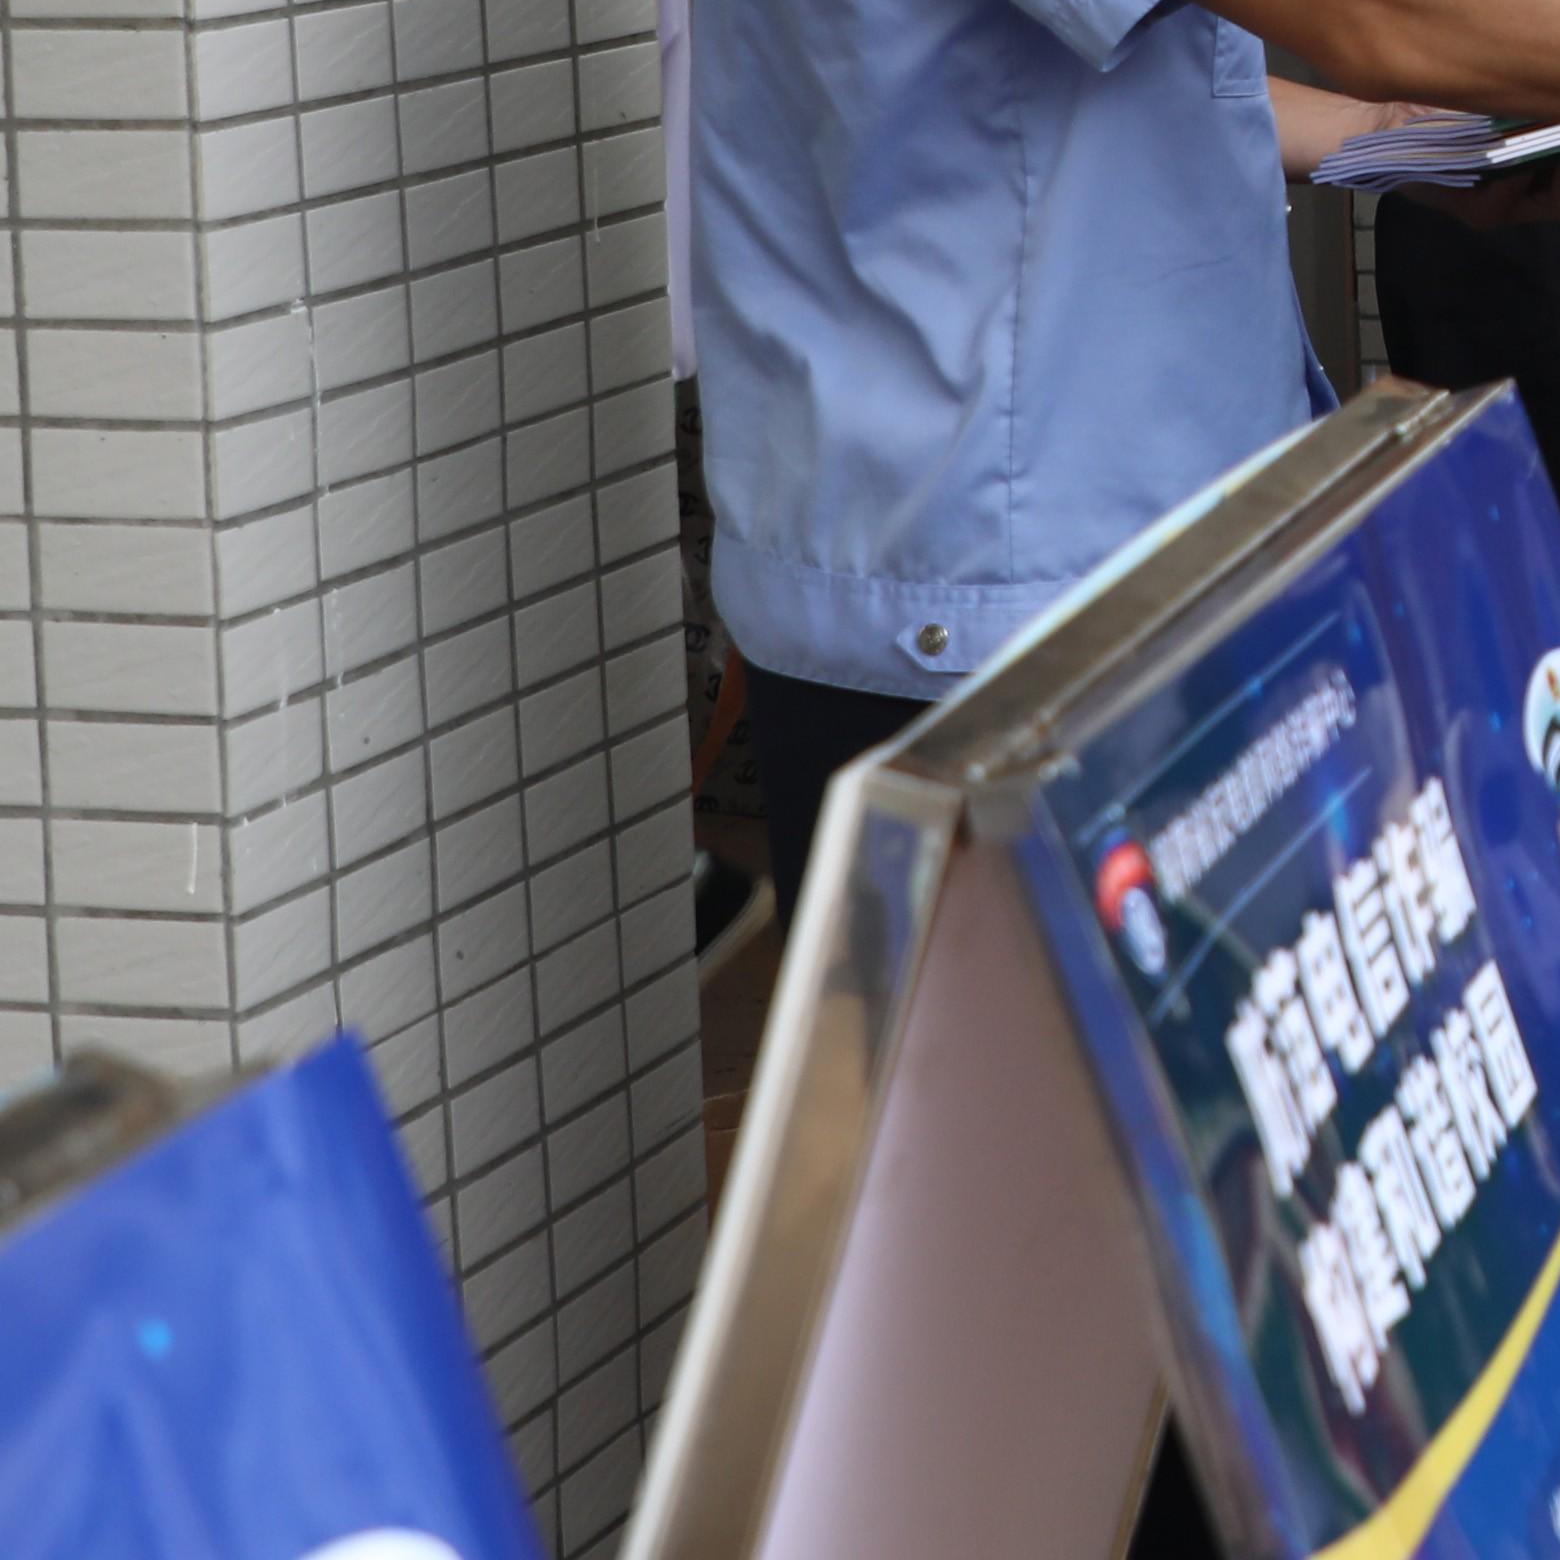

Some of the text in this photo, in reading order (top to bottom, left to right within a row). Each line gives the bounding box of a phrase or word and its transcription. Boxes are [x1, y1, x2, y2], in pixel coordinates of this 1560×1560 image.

[1226, 776, 1476, 1197] 防范电信诈骗
[1297, 962, 1538, 1416] 构建和谐校园
